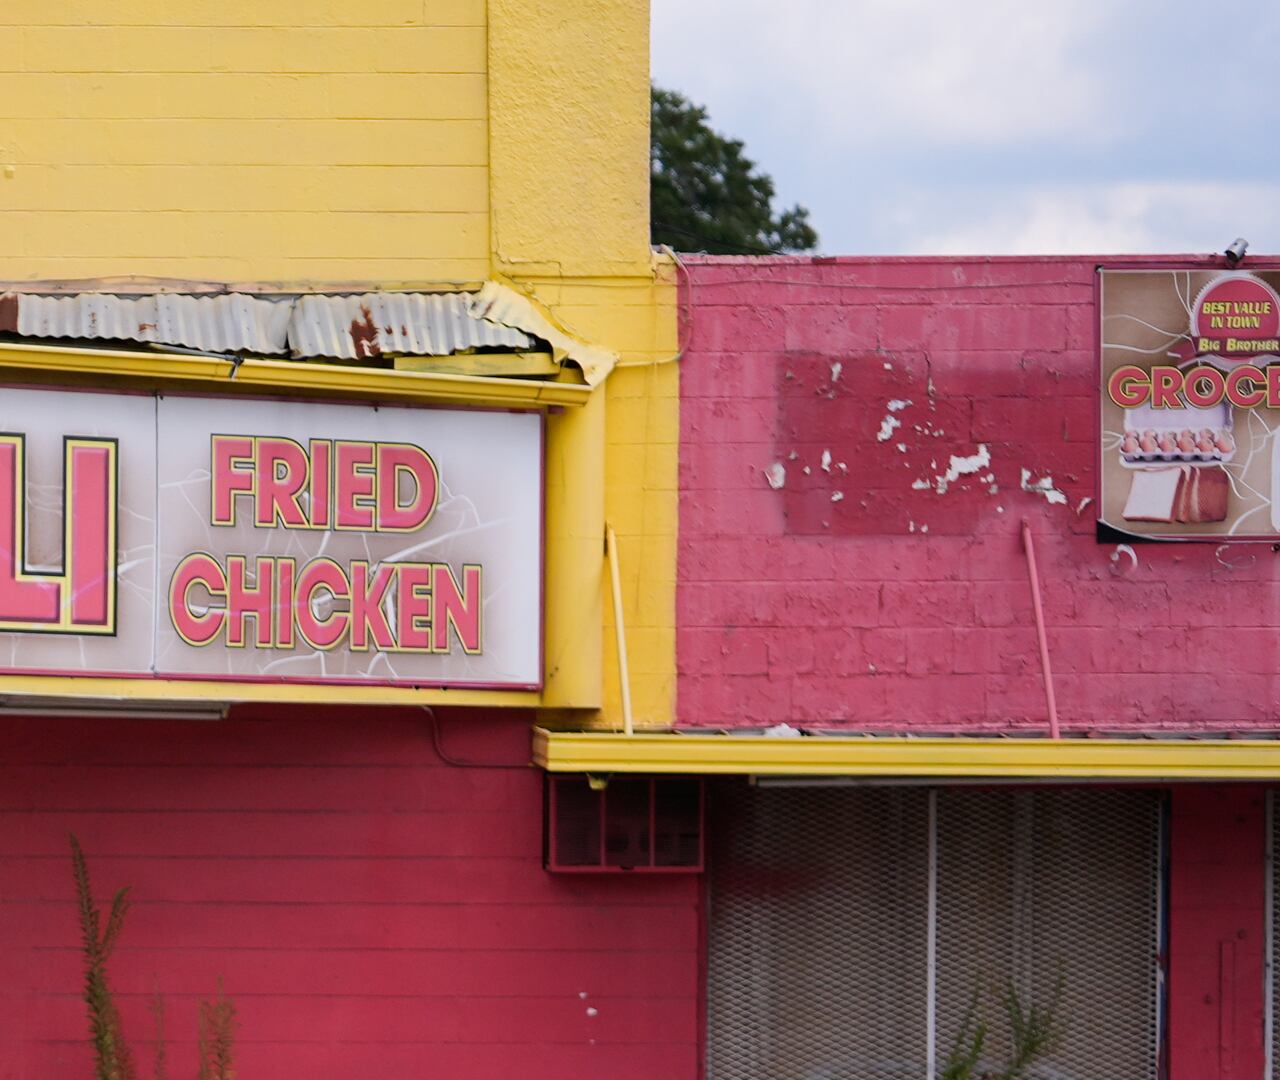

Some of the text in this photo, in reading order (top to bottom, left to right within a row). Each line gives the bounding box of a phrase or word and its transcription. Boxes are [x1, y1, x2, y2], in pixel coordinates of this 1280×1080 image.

[1202, 301, 1272, 315] BEST VALUE
[1210, 315, 1261, 329] IN TOWN
[210, 433, 440, 533] FRIED
[169, 552, 483, 655] CHICKEN
